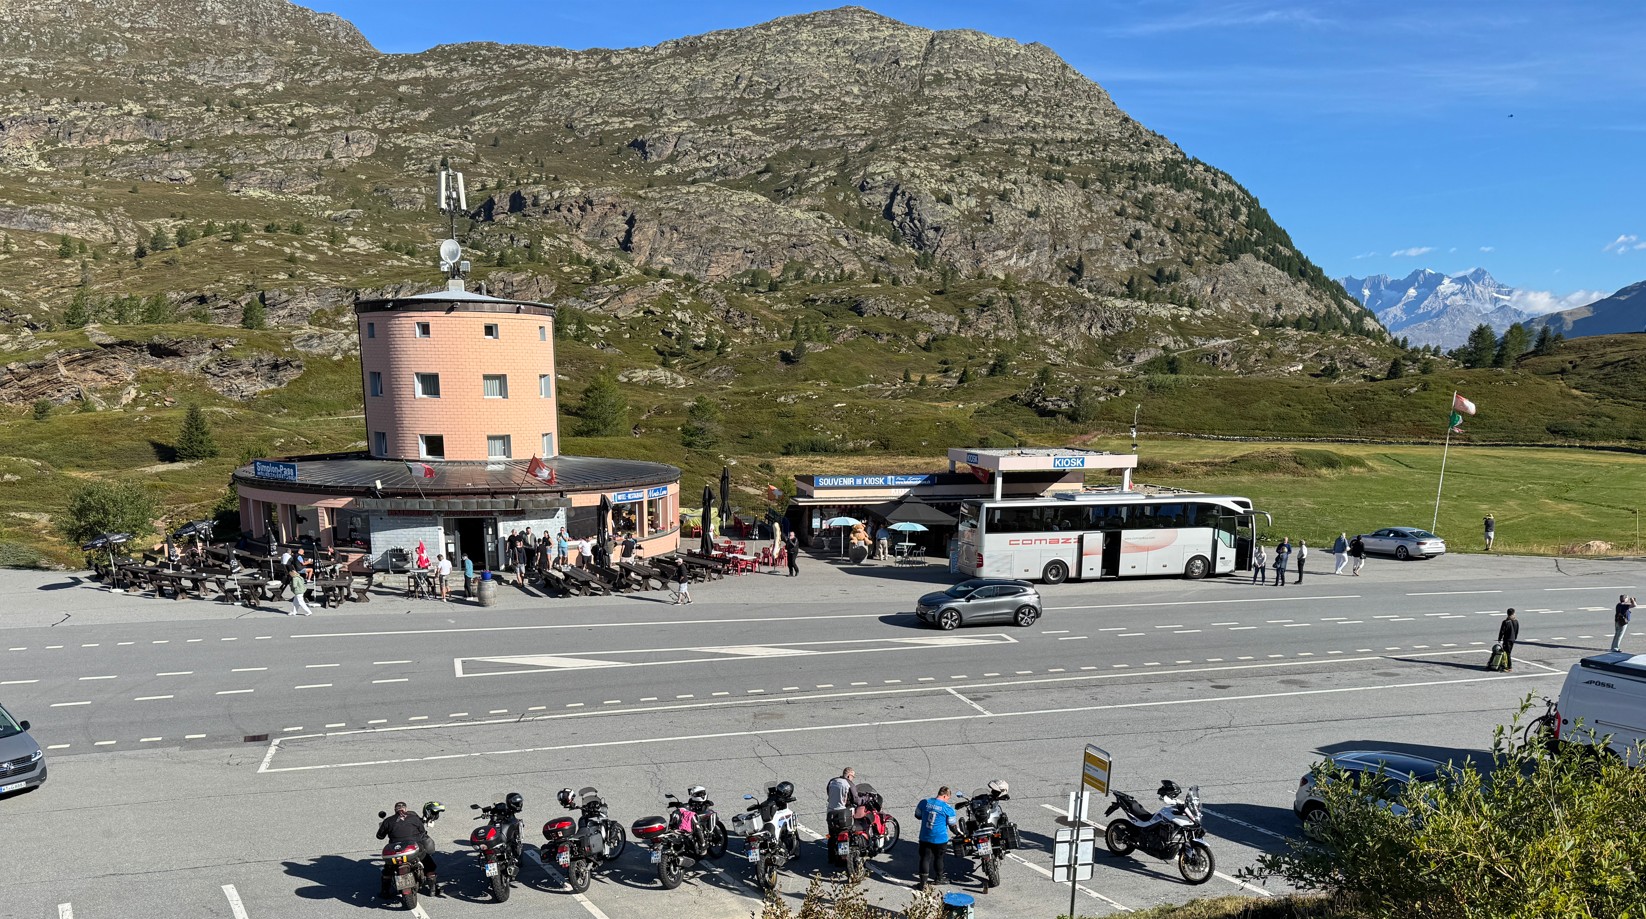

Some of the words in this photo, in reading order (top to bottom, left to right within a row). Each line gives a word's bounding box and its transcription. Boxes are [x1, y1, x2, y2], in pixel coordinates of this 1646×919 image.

[1055, 458, 1083, 467] KIOSK
[818, 477, 855, 486] SOUVENIR
[863, 477, 885, 485] KIOSK
